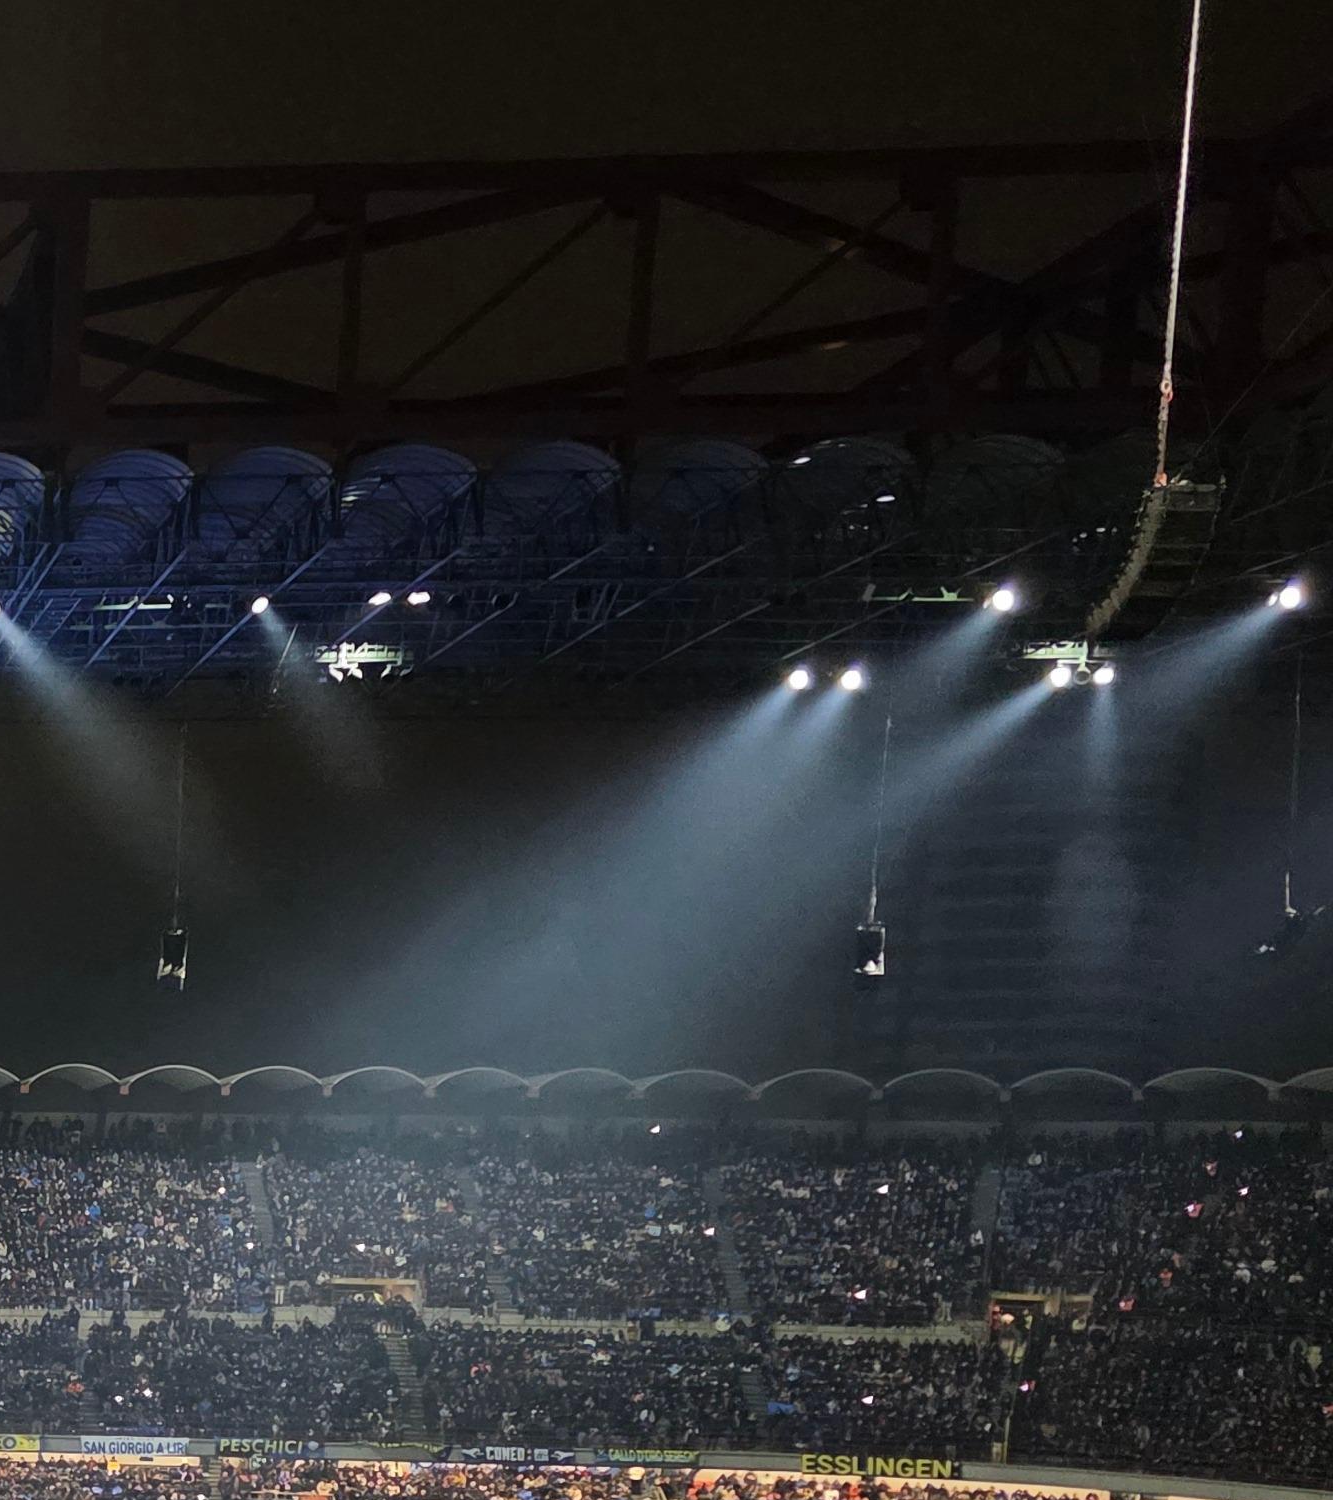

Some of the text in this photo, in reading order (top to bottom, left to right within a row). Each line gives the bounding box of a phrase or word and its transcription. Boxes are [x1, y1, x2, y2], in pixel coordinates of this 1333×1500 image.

[83, 1439, 106, 1455] SAN
[108, 1440, 153, 1455] GIORGIO
[156, 1441, 164, 1454] A
[218, 1438, 303, 1455] PESCHICI
[485, 1446, 526, 1462] CUNEO
[801, 1454, 954, 1478] ESSLINGEN
